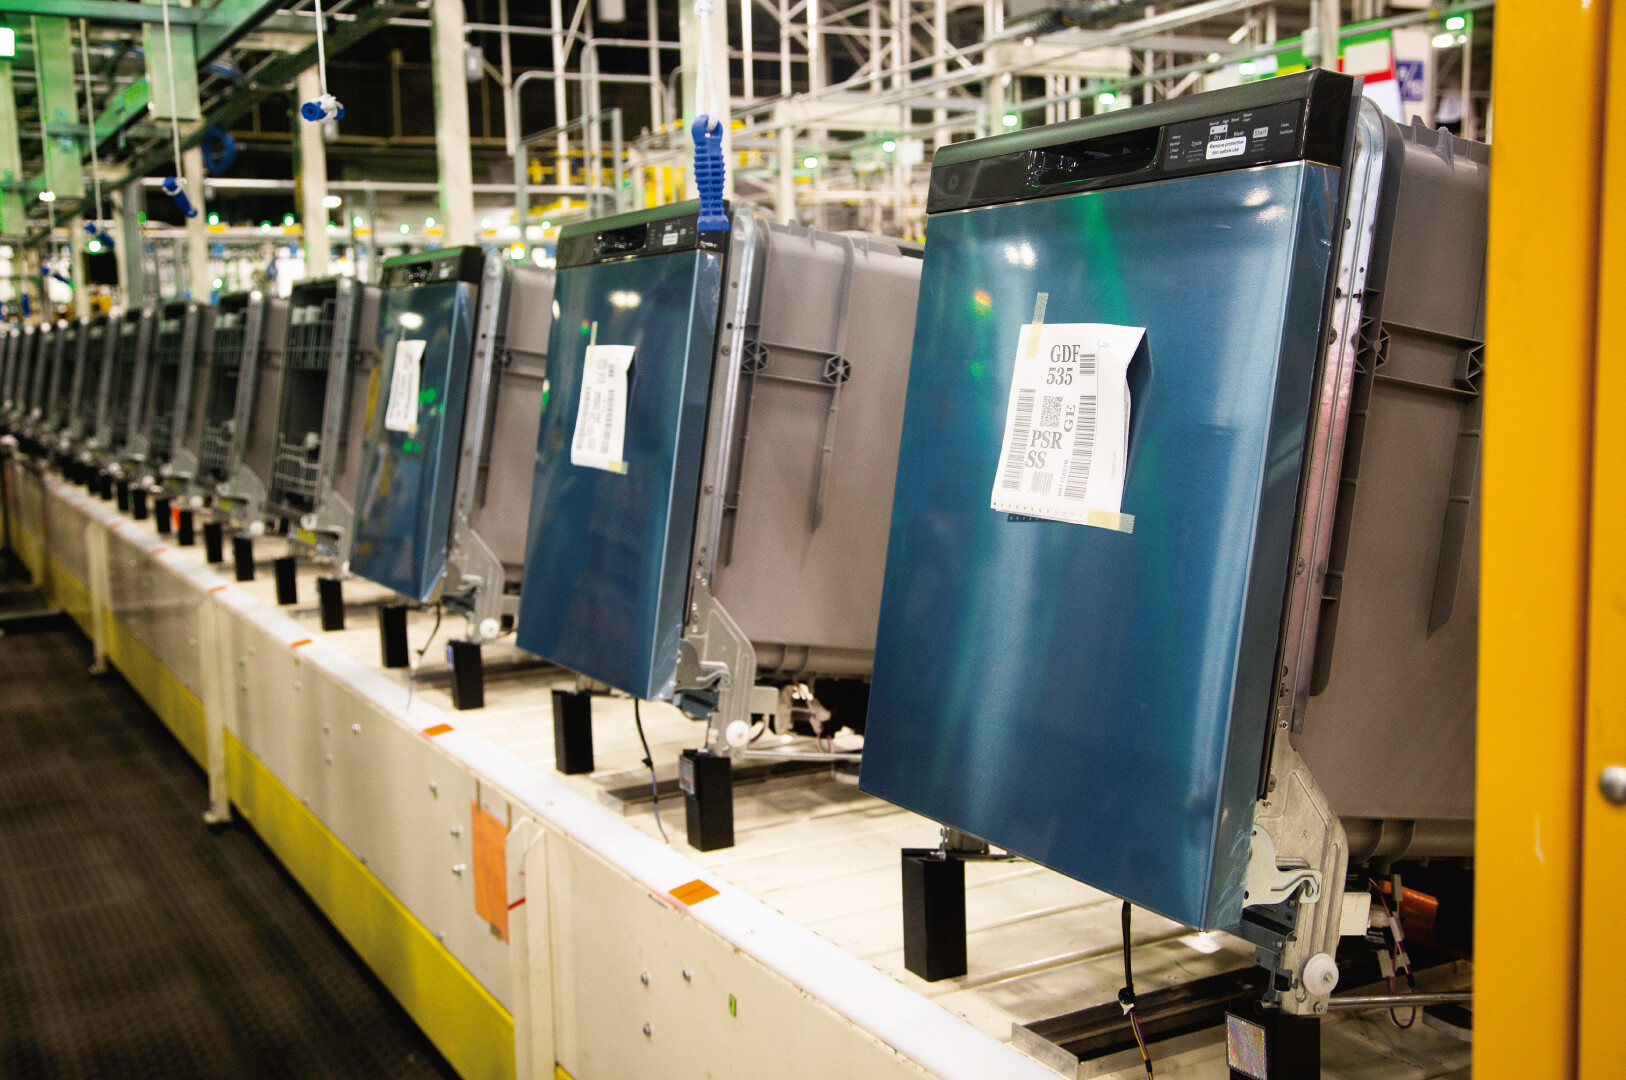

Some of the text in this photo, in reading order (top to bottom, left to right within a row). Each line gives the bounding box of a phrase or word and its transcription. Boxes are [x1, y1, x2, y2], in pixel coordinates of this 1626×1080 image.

[1225, 140, 1244, 148] protective
[1050, 344, 1081, 363] GDF
[1046, 367, 1074, 386] 535
[1063, 404, 1076, 433] GE
[1030, 429, 1063, 450] PSR
[1025, 450, 1047, 469] SS
